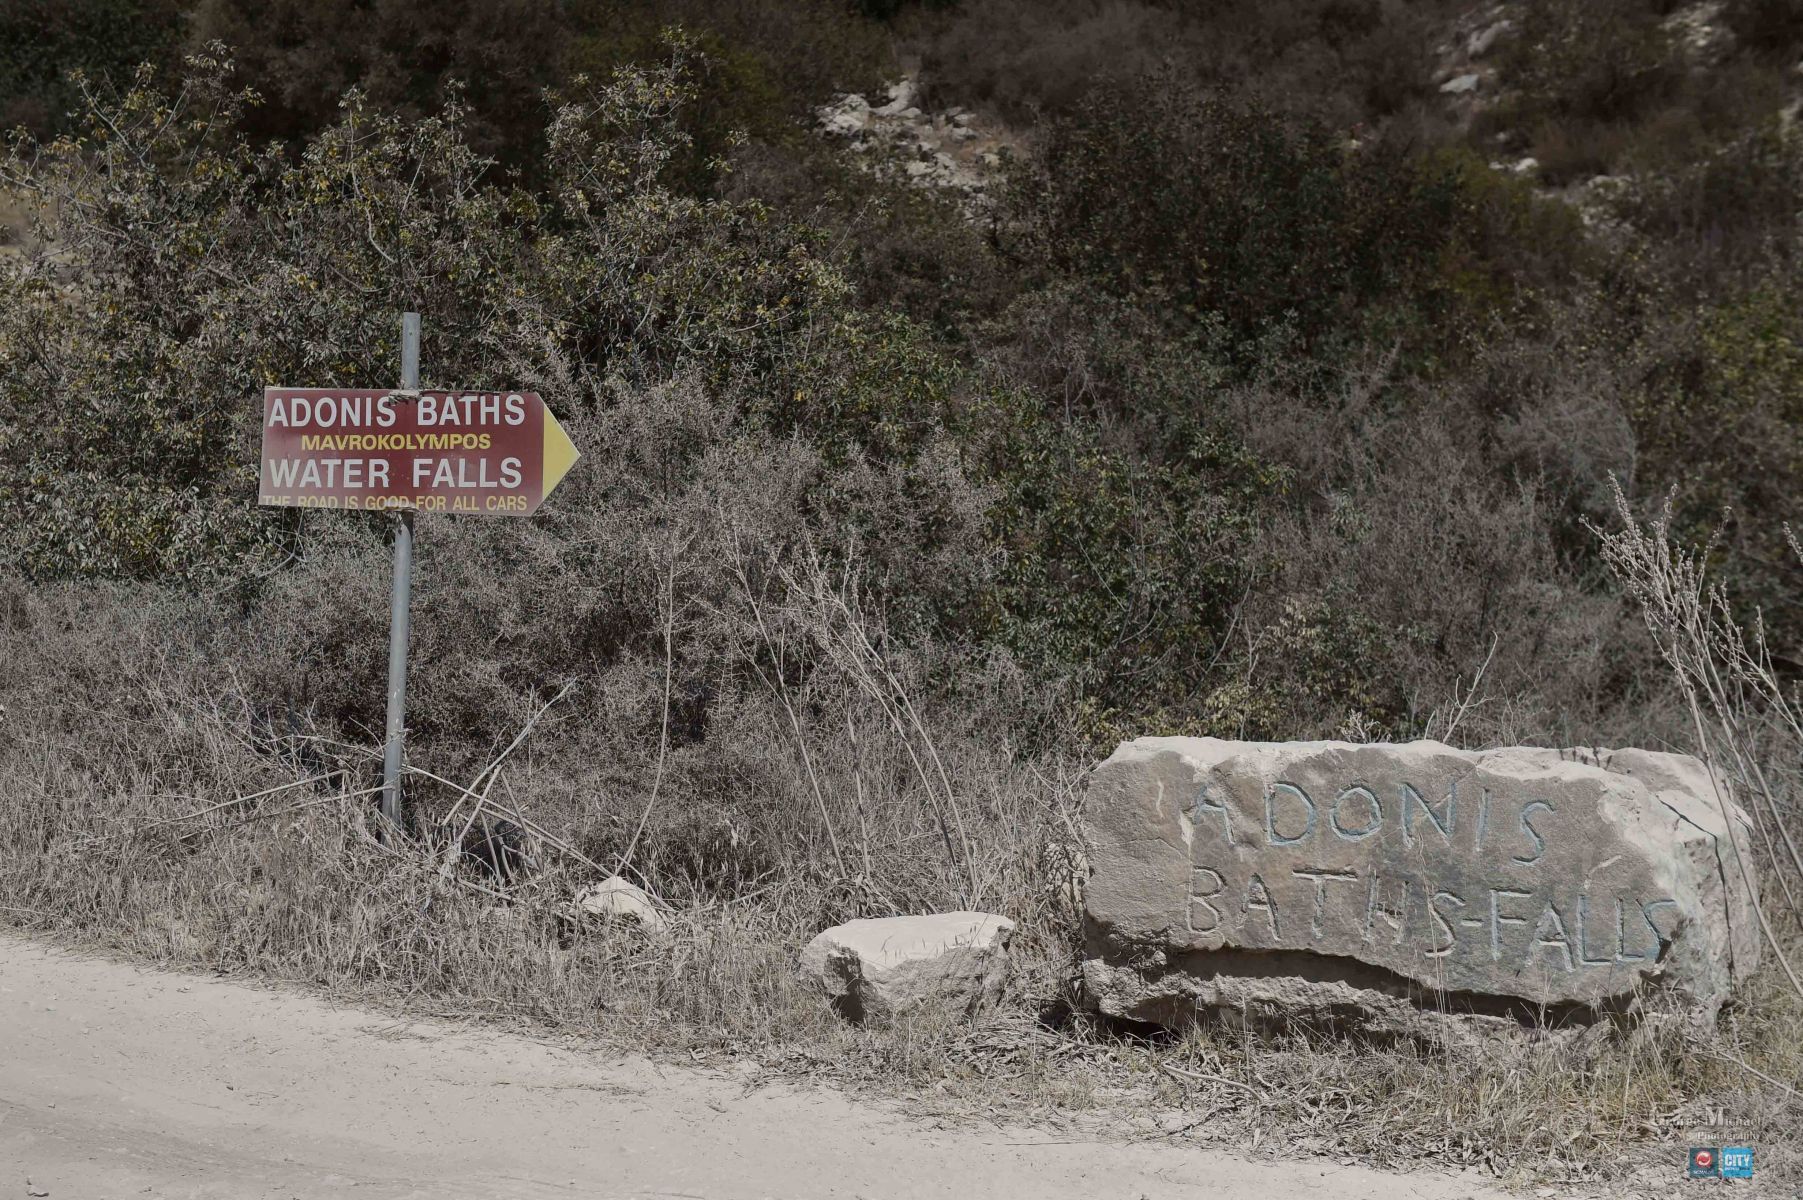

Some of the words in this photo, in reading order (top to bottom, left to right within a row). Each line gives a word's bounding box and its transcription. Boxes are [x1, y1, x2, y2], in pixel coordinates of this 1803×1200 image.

[268, 396, 397, 427] ADONIS
[416, 394, 526, 426] BATHS
[301, 433, 491, 451] MAVROKOLYMPOS
[268, 458, 390, 488] WATER
[412, 457, 522, 489] FALLS
[297, 495, 339, 508] ROAD
[344, 495, 359, 509] IS
[365, 495, 410, 511] GOOD
[415, 495, 447, 511] FOR
[452, 495, 480, 511] ALL
[485, 495, 528, 511] CARS
[1181, 779, 1555, 867] ADONIS
